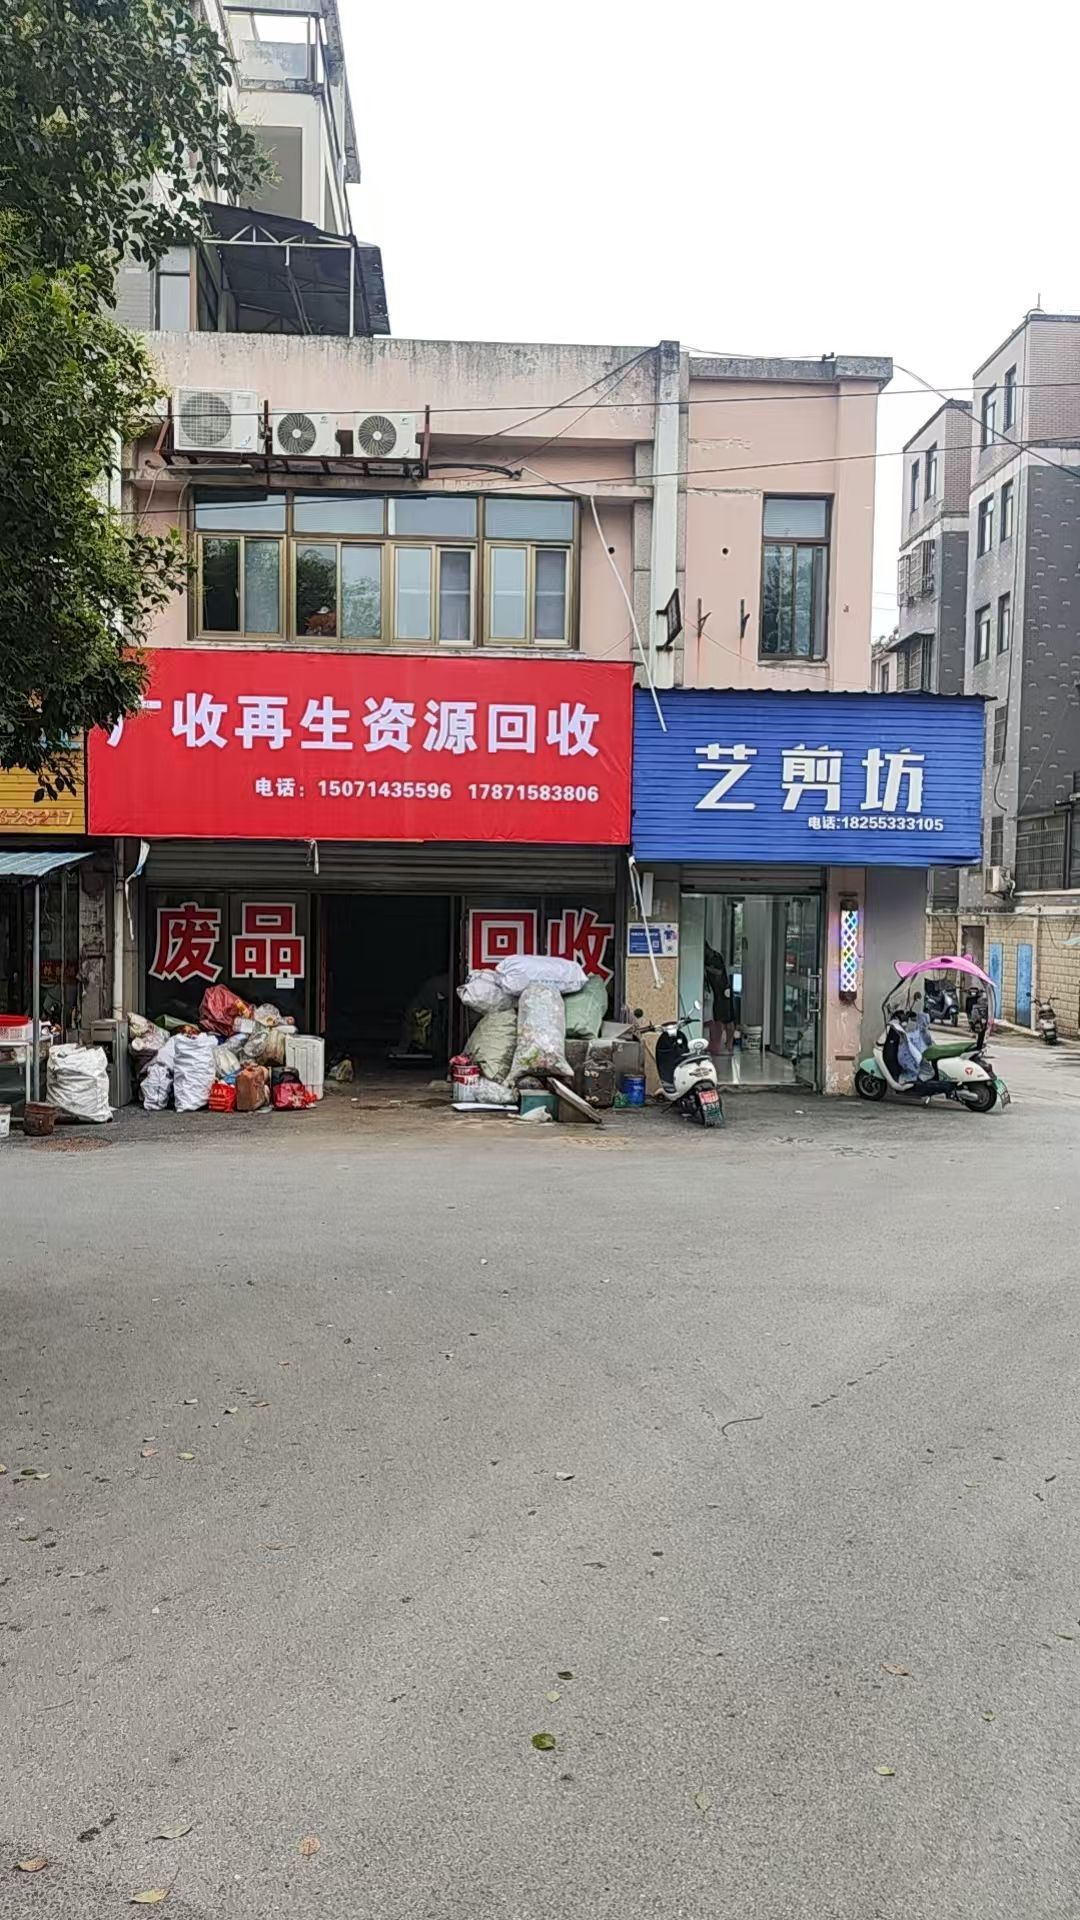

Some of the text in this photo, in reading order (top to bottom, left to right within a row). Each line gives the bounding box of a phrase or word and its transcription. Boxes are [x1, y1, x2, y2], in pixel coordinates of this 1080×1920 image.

[318, 780, 452, 800] 15071435596
[468, 784, 599, 802] 17871583806
[694, 743, 925, 813] 艺剪坊
[149, 902, 305, 982] 废品
[469, 907, 614, 984] 回收
